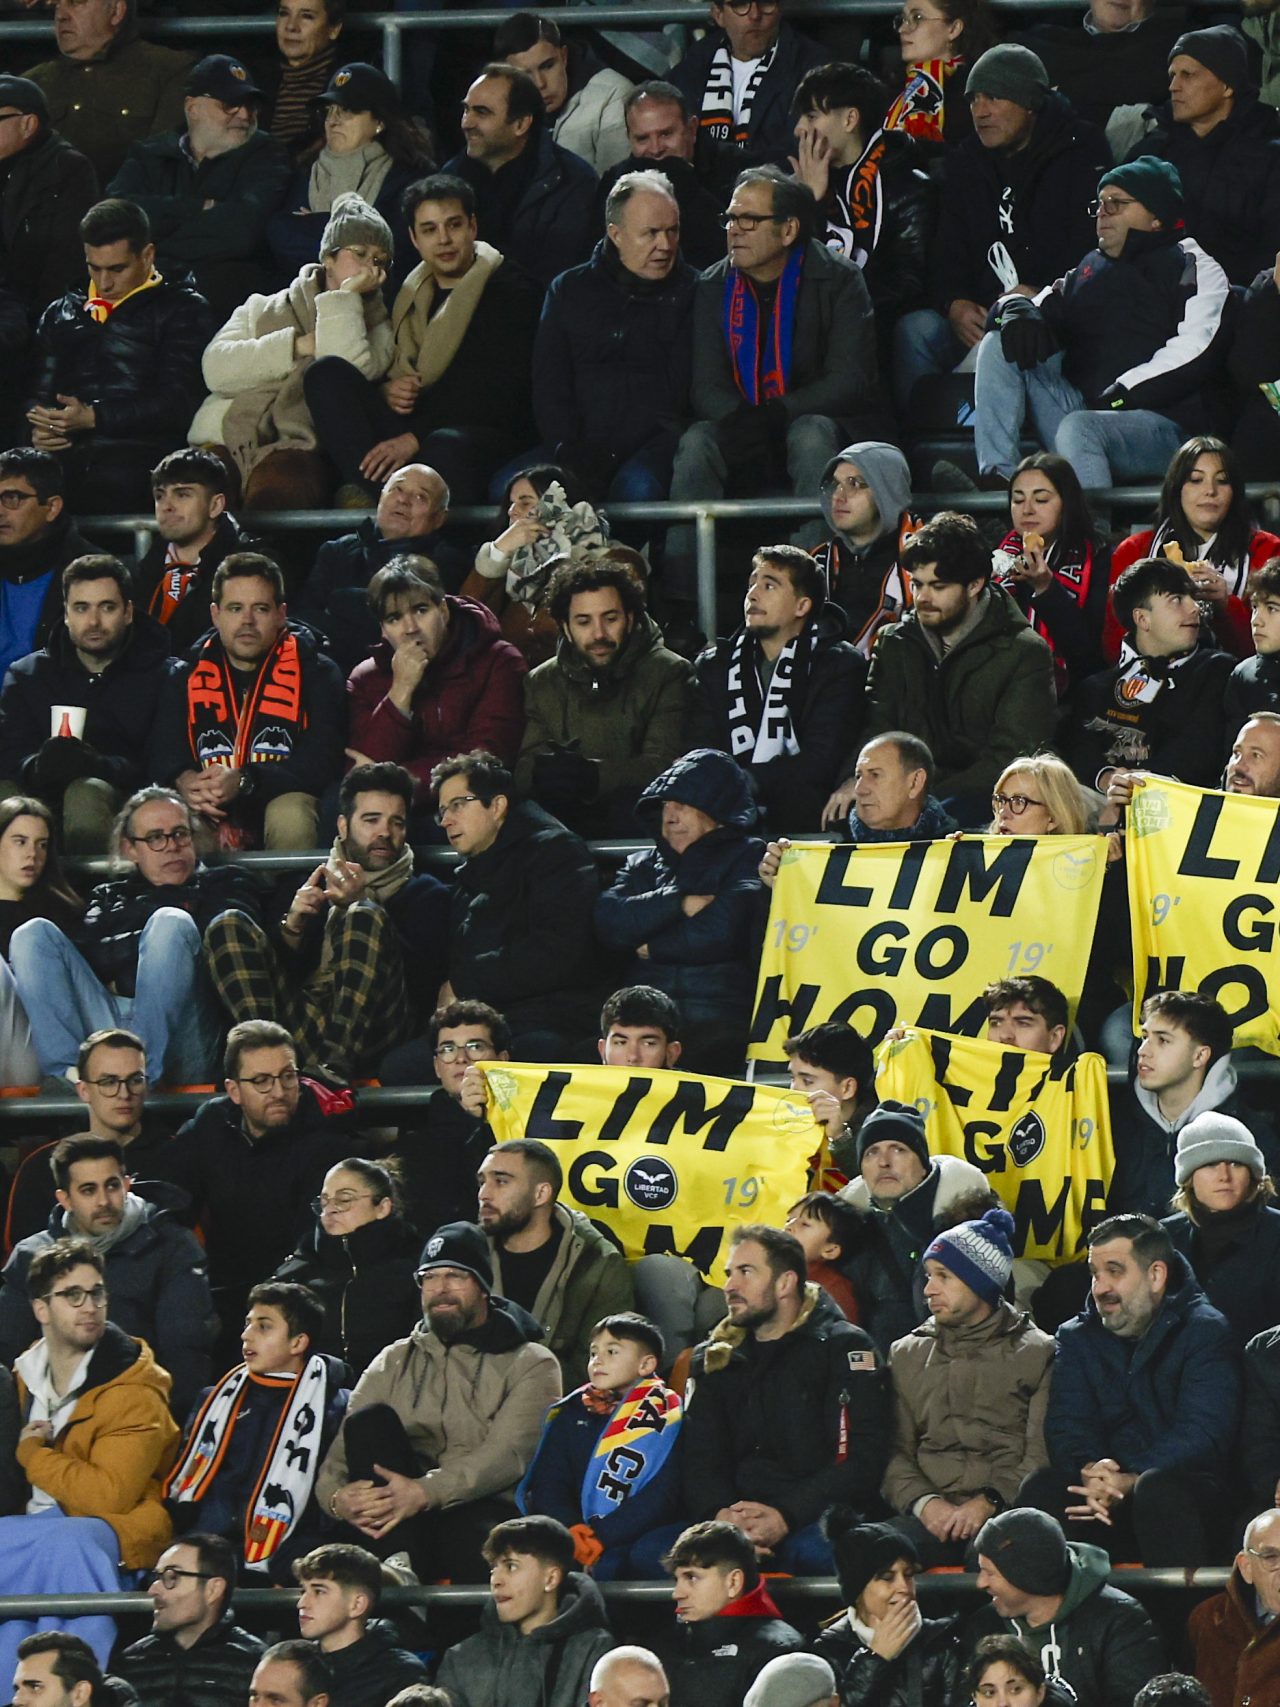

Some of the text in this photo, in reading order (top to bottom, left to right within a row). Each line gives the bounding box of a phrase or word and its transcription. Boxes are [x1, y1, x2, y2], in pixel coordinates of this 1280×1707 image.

[815, 839, 1038, 917] LIM
[1149, 894, 1180, 926] 9'
[857, 920, 969, 980] GO
[1006, 941, 1054, 973] 19'
[750, 974, 992, 1047] HOM
[525, 1071, 756, 1151] LIM
[633, 1183, 670, 1194] LIBERTAD
[644, 1191, 658, 1200] VCF
